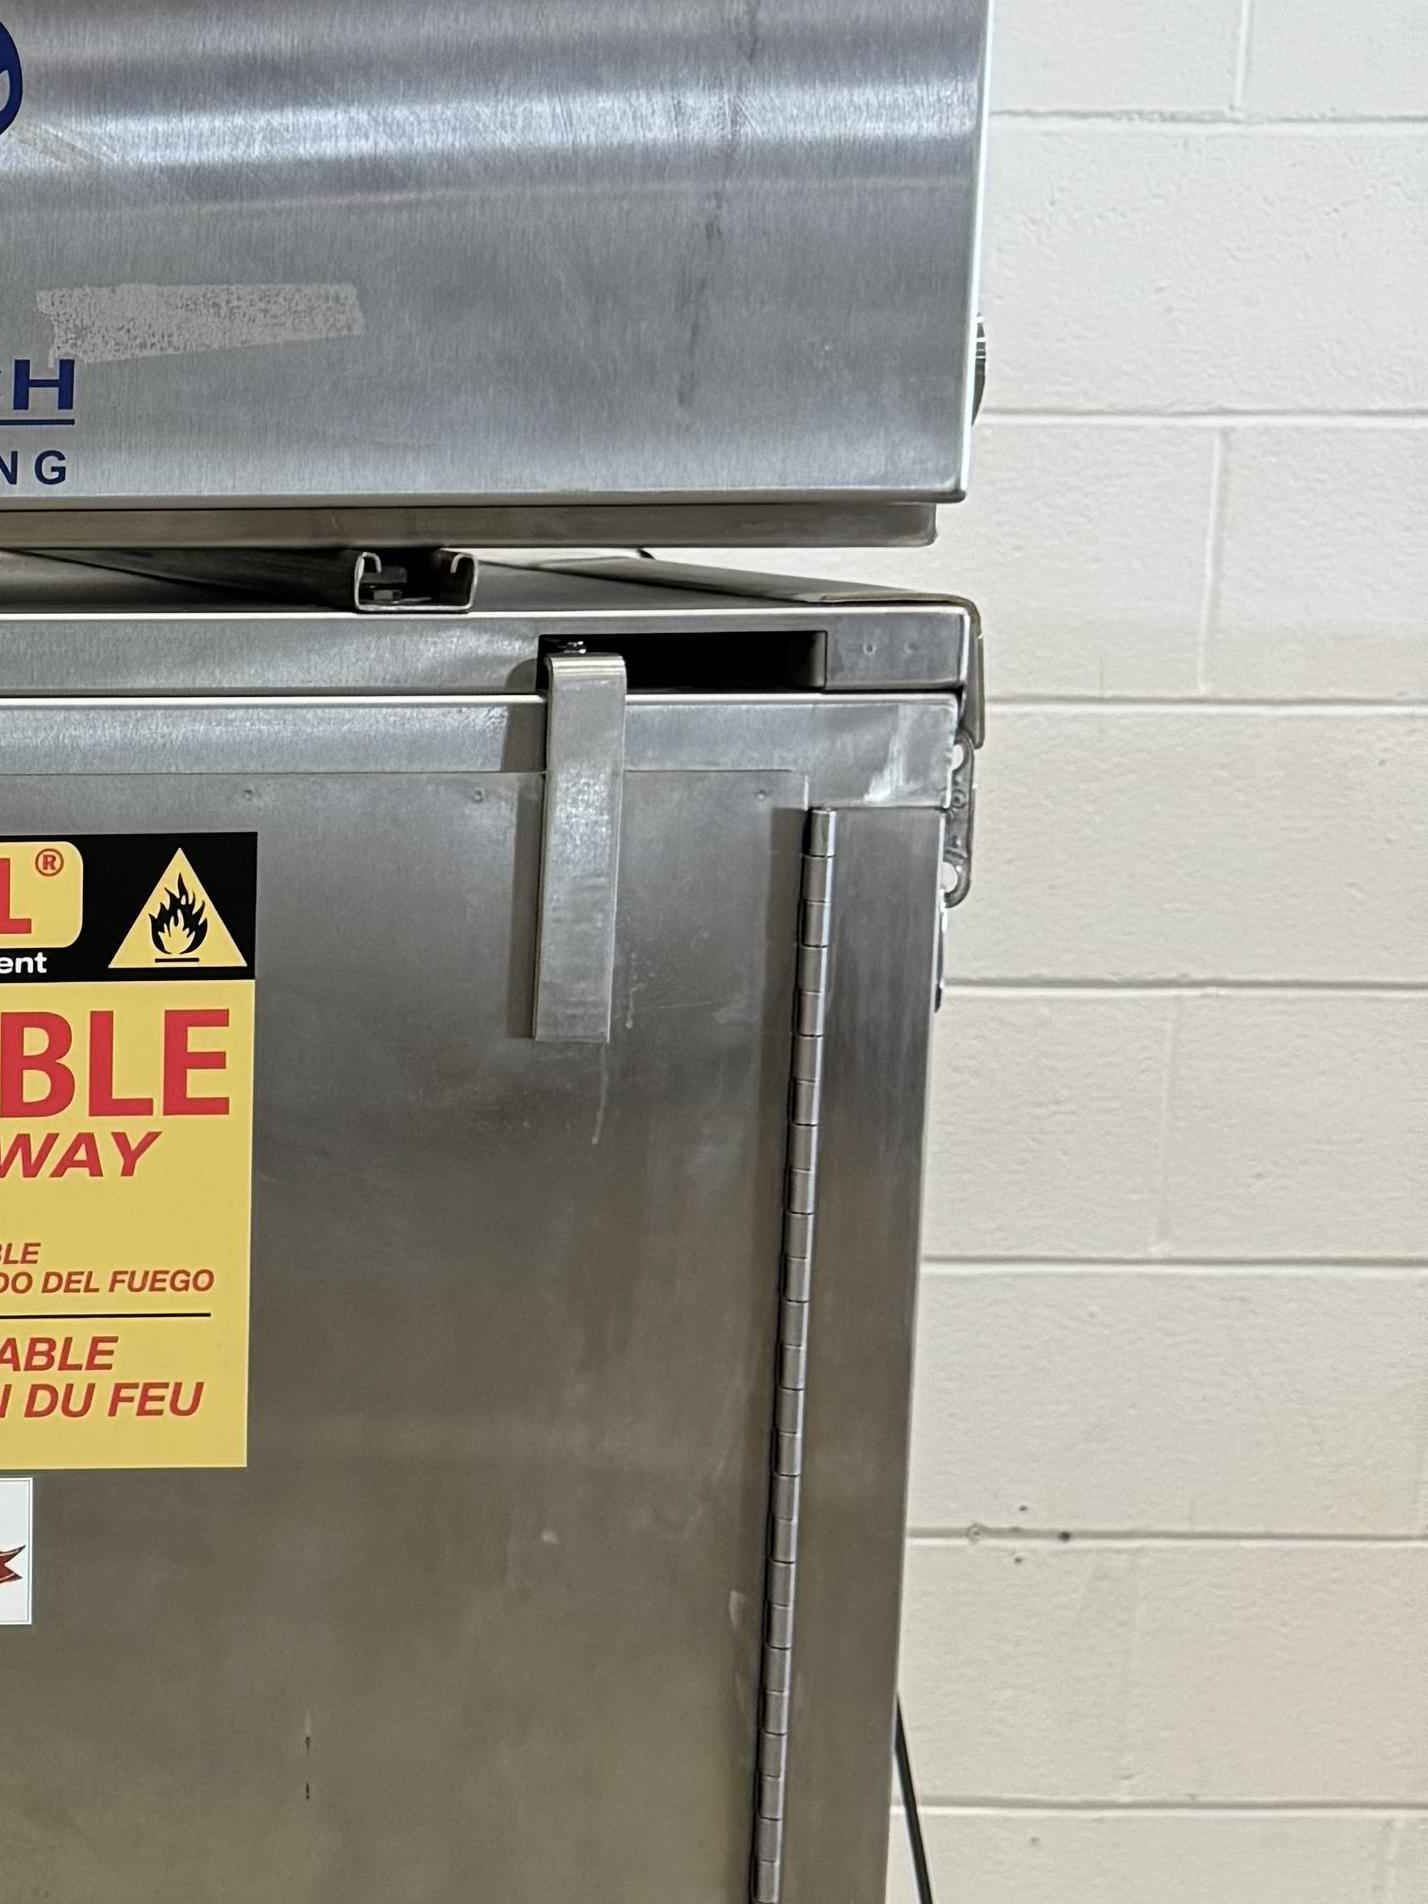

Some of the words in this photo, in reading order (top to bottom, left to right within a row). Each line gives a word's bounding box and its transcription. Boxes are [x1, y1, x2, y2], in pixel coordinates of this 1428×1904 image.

[41, 1270, 101, 1295] DEL
[108, 1268, 215, 1294] FUEGO
[23, 1382, 95, 1420] DU
[107, 1380, 206, 1417] FEU
